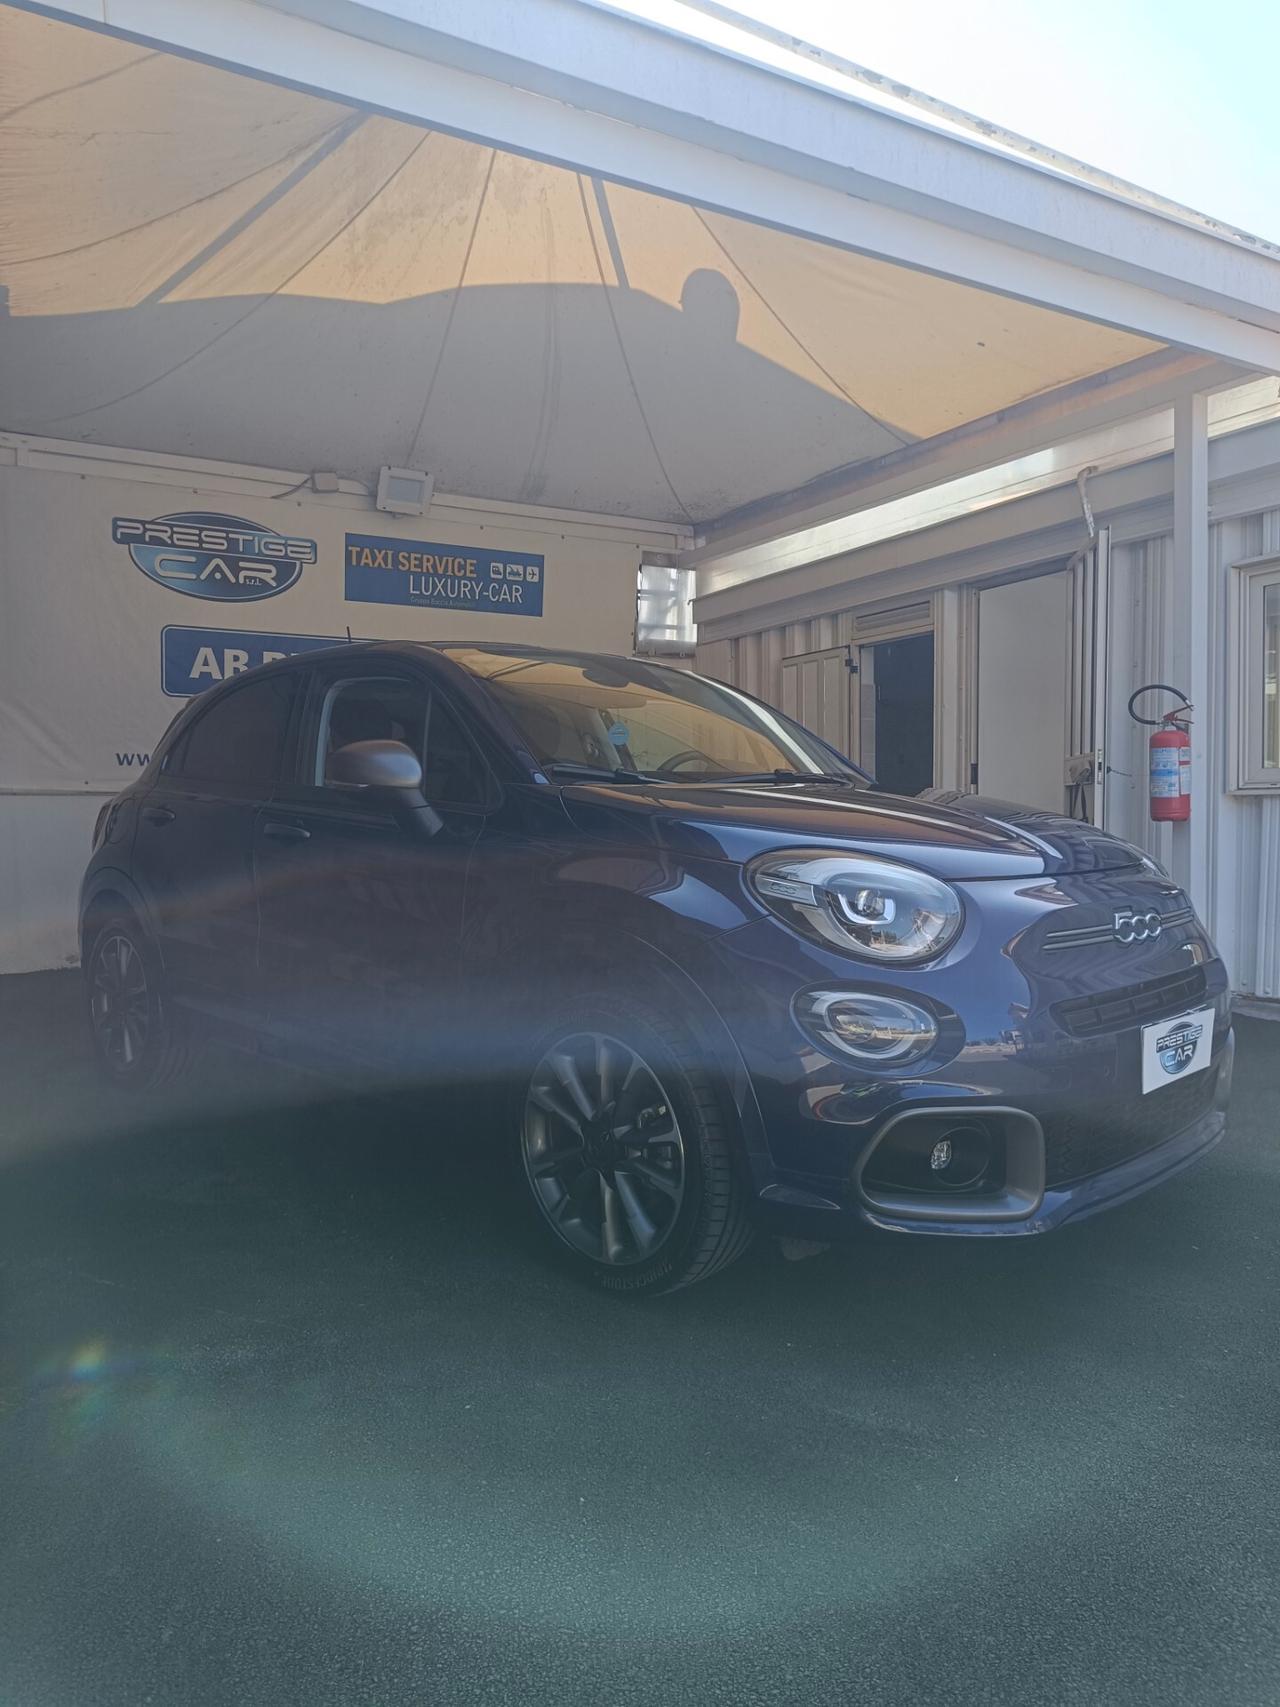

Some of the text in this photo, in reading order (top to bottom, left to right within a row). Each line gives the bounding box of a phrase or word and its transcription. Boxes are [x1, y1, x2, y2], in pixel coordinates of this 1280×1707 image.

[116, 521, 315, 563] PRESTIGE
[154, 553, 277, 587] CAR
[348, 546, 477, 578] TAXI SERVICE
[409, 575, 523, 604] LUXURY-CAR
[1114, 911, 1162, 943] 500
[1156, 1024, 1203, 1051] PRESTIGE
[1165, 1044, 1193, 1066] CAR
